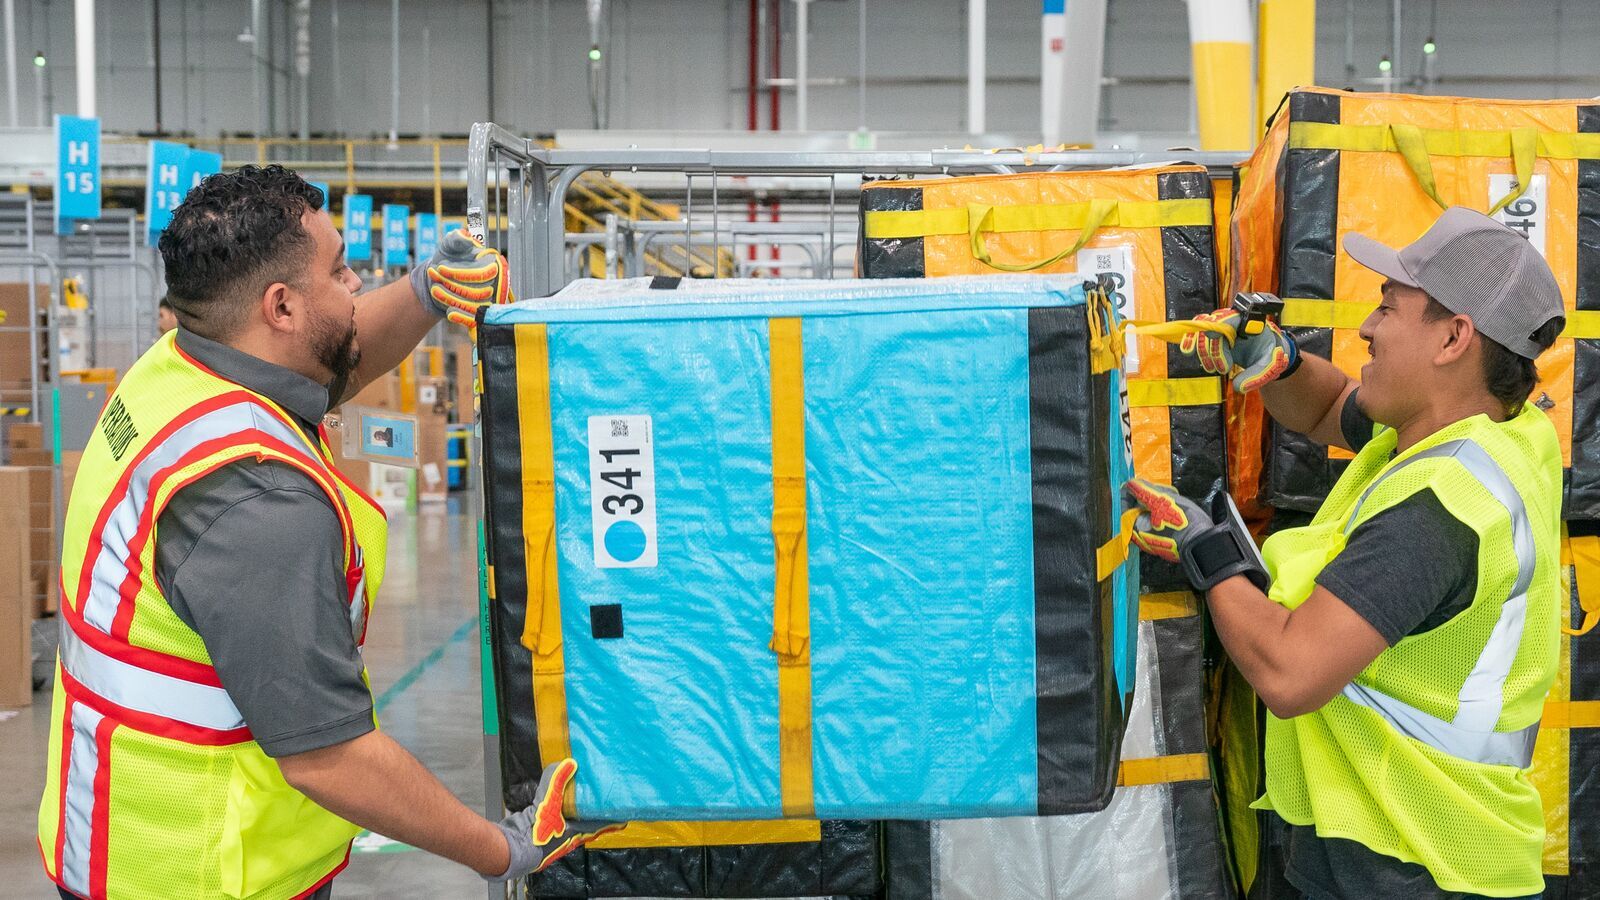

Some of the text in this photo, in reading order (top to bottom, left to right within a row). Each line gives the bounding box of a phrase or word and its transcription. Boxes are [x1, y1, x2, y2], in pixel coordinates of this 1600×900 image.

[68, 140, 89, 166] H
[64, 172, 94, 194] 15
[159, 164, 178, 186] H
[101, 394, 139, 461] OPERATIONS
[599, 448, 644, 516] 341
